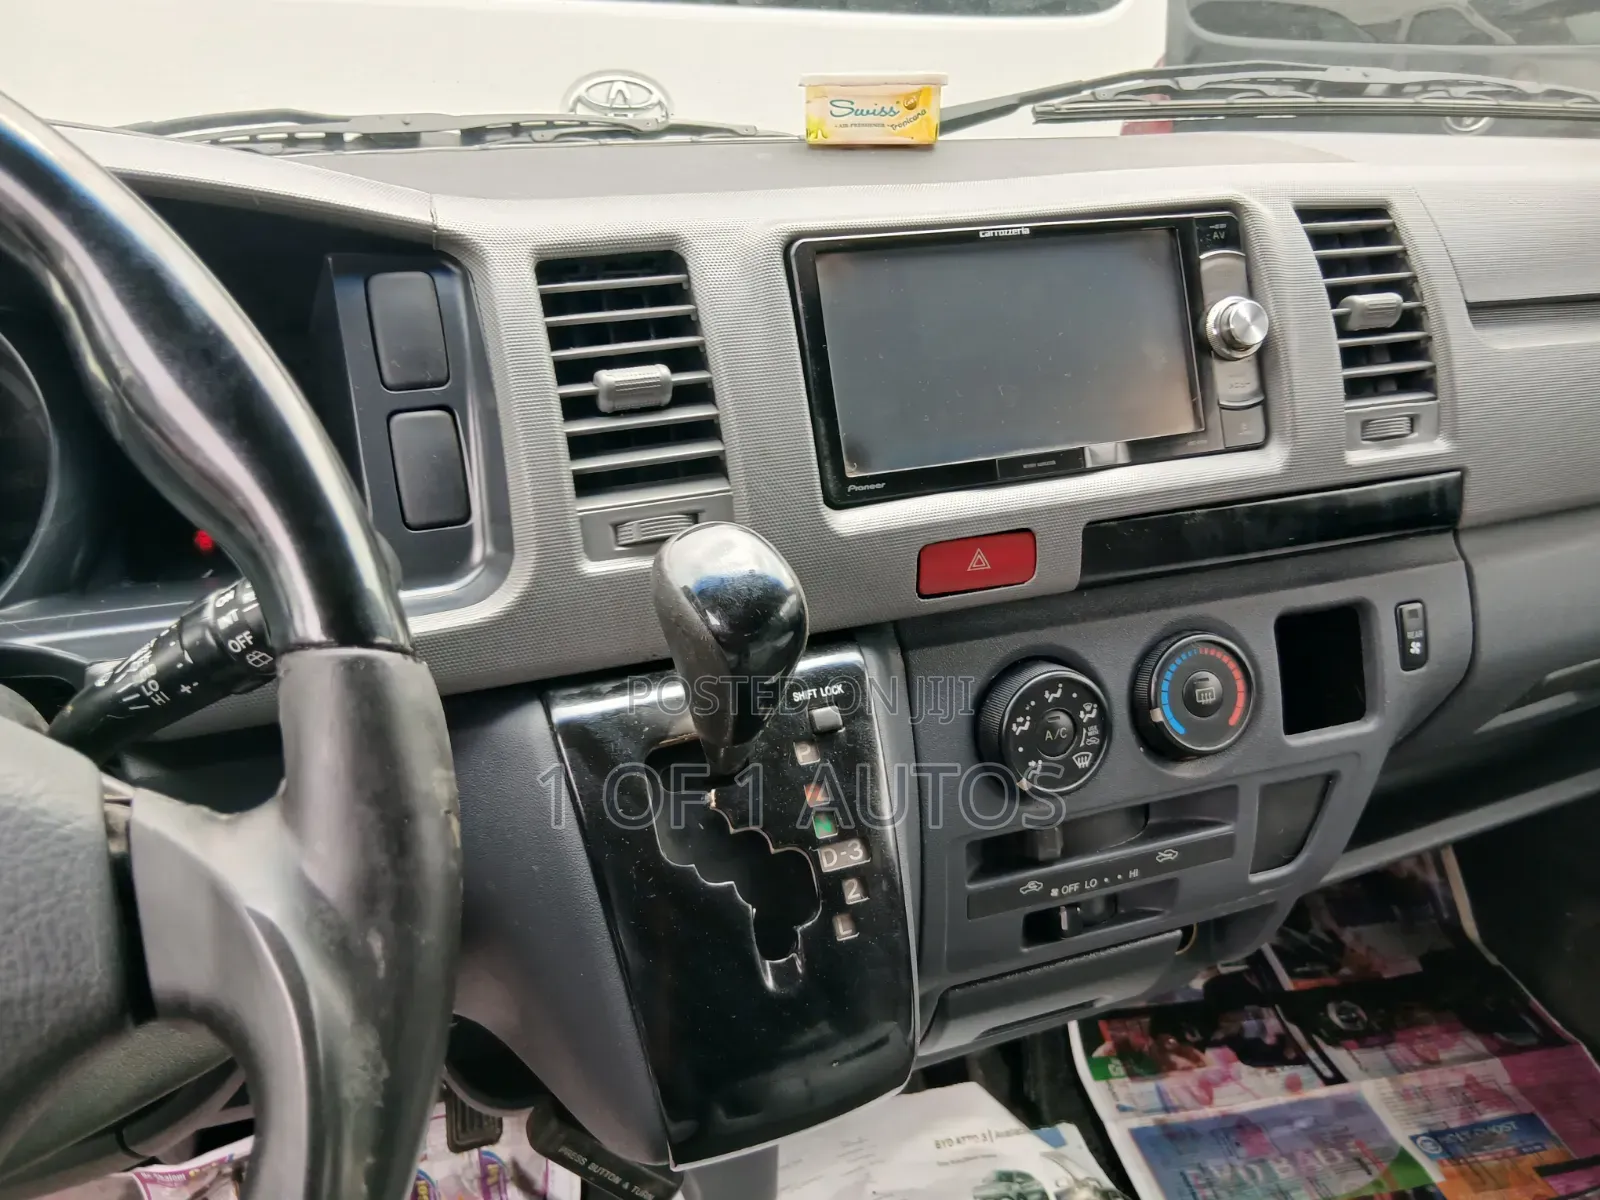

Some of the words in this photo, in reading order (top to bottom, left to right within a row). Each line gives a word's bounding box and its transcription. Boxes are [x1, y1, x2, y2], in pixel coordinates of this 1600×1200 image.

[829, 99, 900, 118] Swiss
[1213, 231, 1226, 240] AV
[847, 481, 886, 493] Pioneer
[227, 630, 256, 653] OFF
[141, 679, 160, 696] LO
[792, 688, 817, 702] SHIFT
[820, 684, 845, 697] LOCK
[151, 691, 171, 706] HI
[1044, 728, 1067, 742] A/C
[821, 840, 864, 868] D-3
[846, 878, 861, 900] 2
[1061, 882, 1080, 895] OFF
[1084, 878, 1098, 890] LO
[1128, 868, 1139, 879] HI
[837, 917, 852, 935] L
[559, 1146, 588, 1166] PRESS
[588, 1162, 622, 1185] BUTTON
